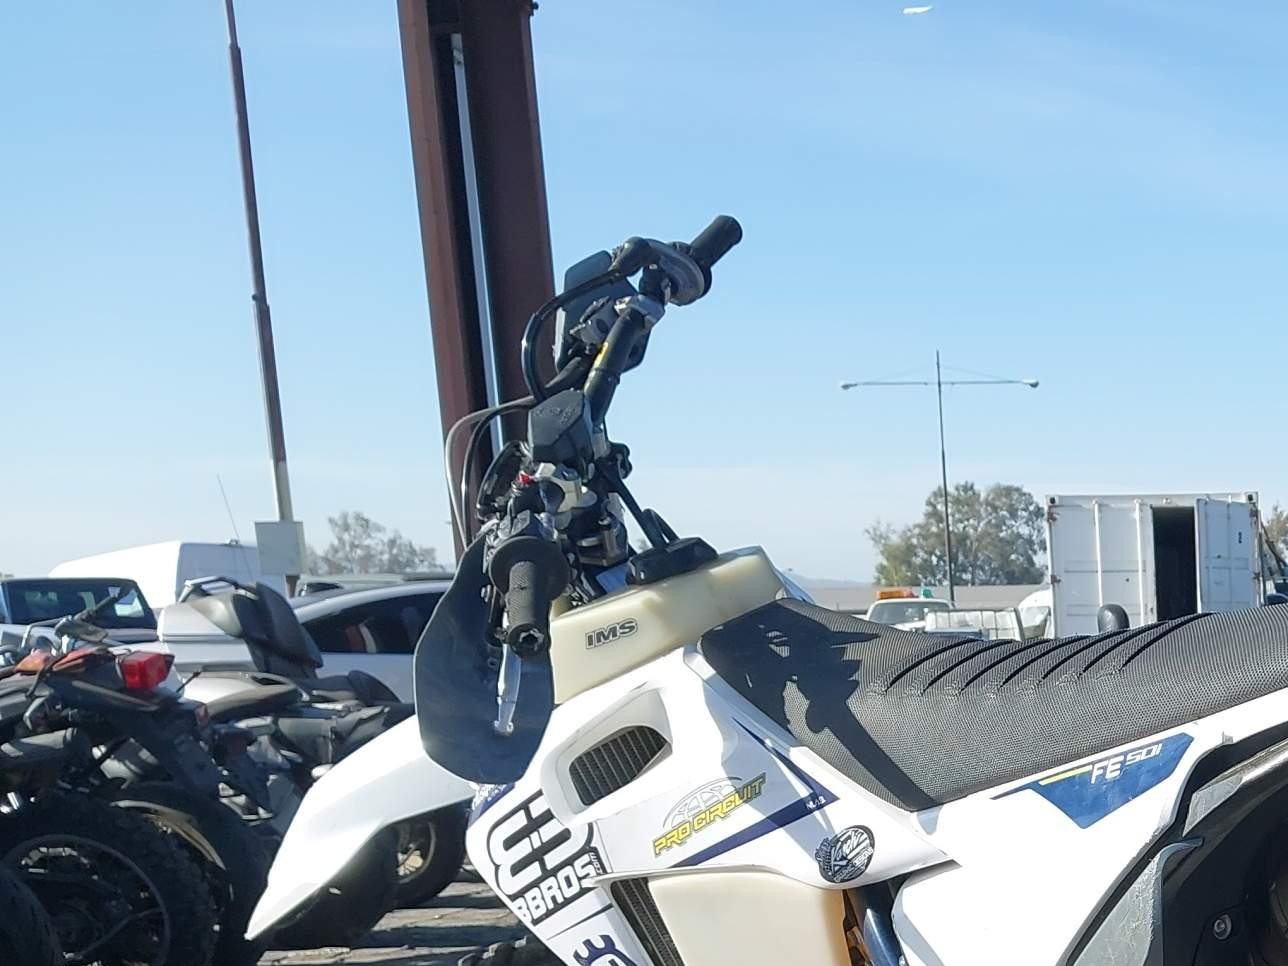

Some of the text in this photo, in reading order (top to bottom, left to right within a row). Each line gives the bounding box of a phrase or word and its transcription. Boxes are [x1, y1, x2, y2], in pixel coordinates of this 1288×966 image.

[585, 617, 638, 650] IMS
[1091, 743, 1162, 784] FE 501
[653, 772, 767, 857] PRO CIRCUIT
